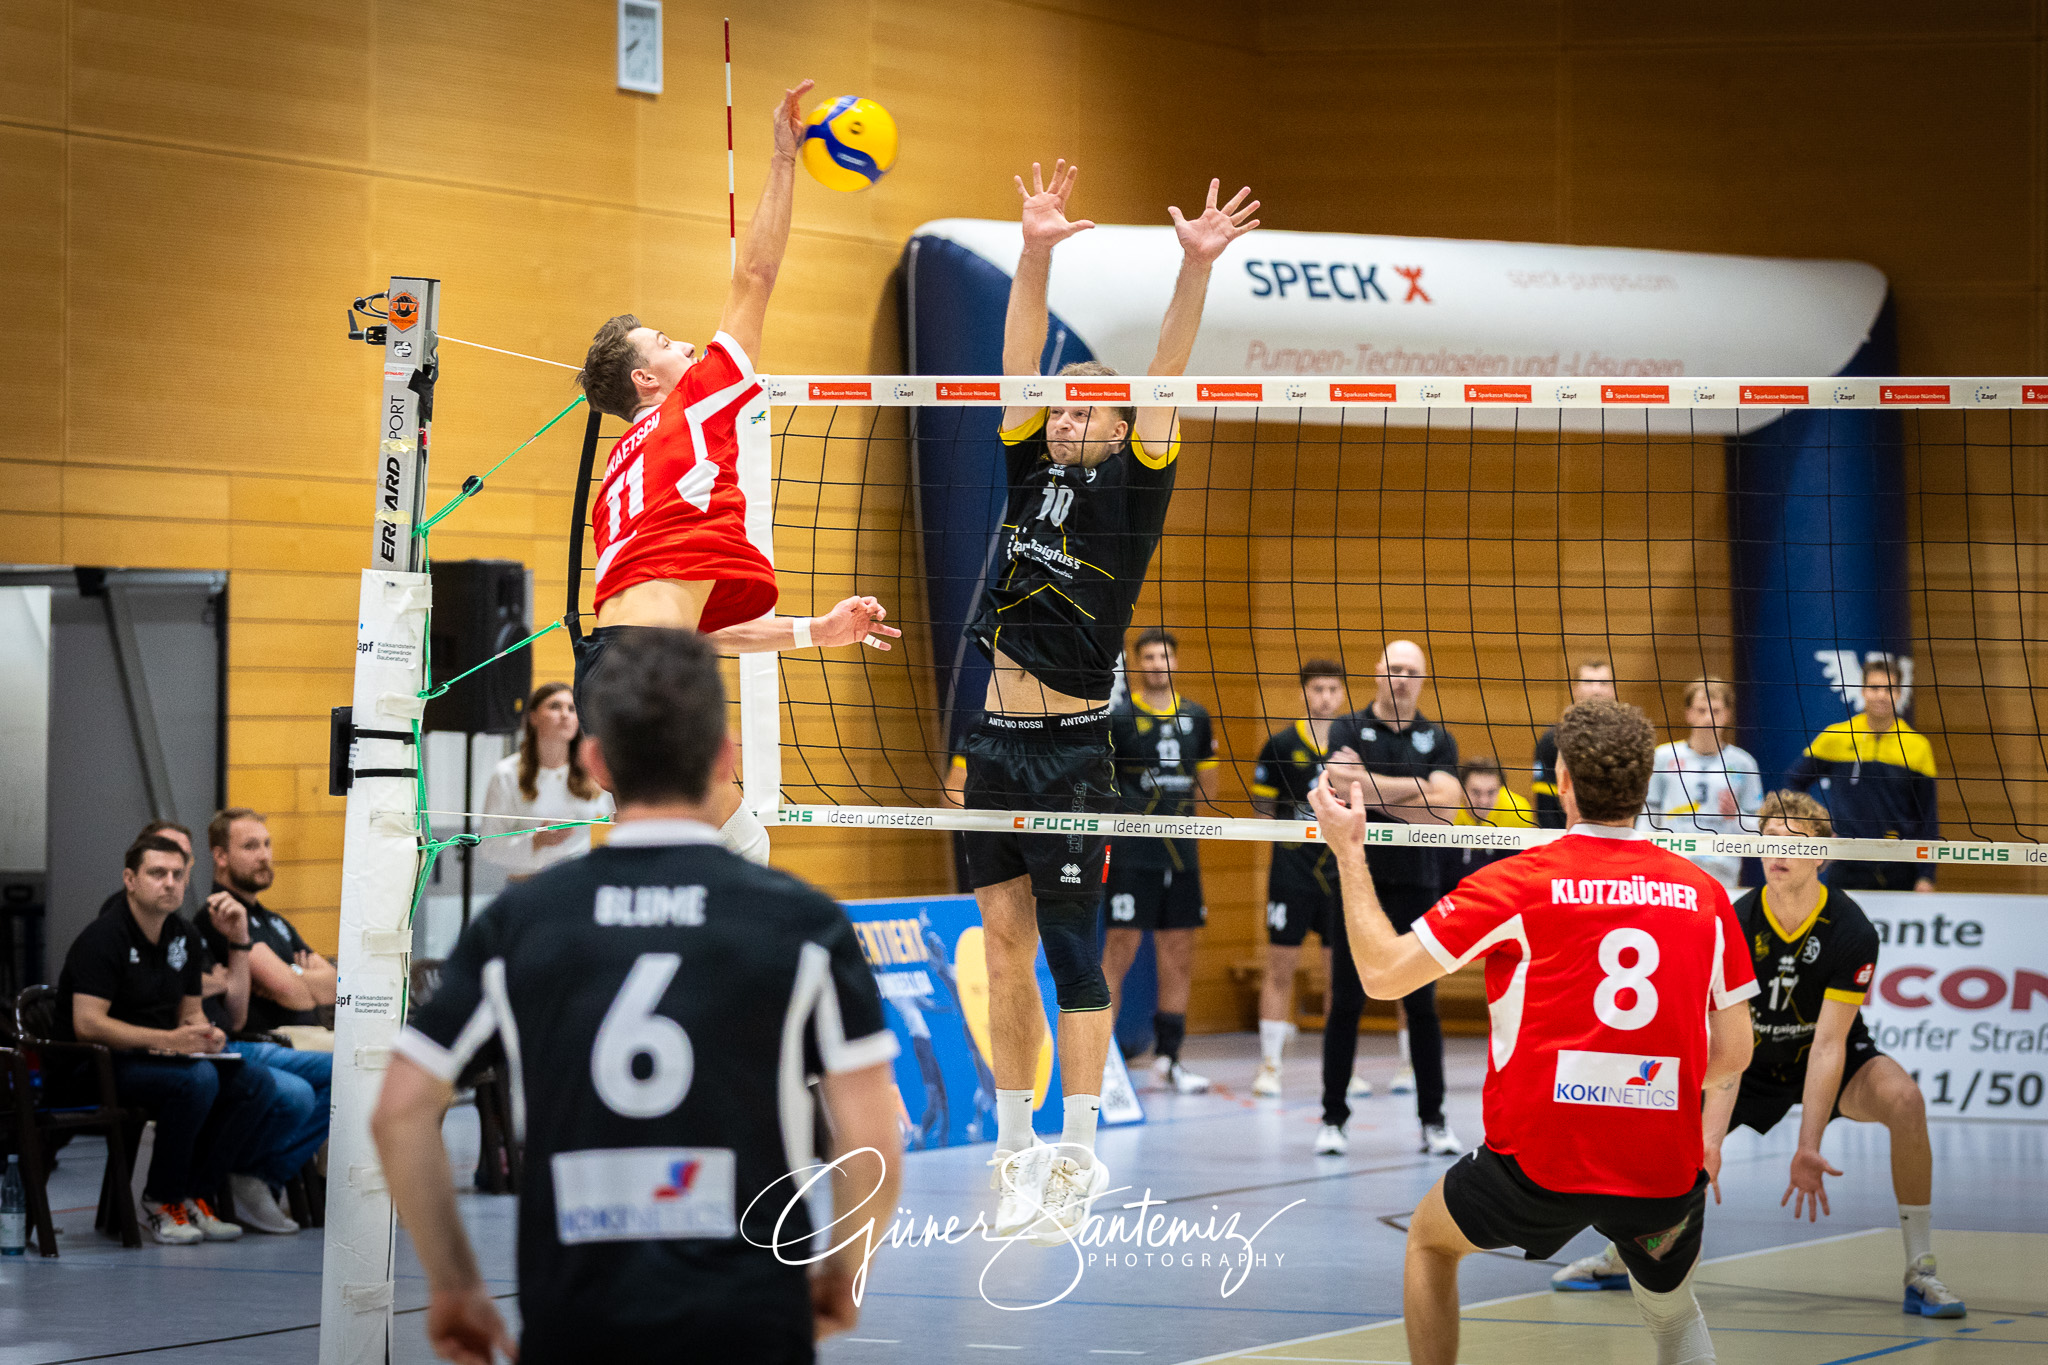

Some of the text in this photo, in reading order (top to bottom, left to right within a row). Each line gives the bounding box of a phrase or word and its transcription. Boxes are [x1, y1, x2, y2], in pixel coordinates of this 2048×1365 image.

[1245, 260, 1389, 302] SPECK
[389, 395, 405, 440] PORT
[381, 457, 400, 563] ERARD
[606, 453, 645, 543] 11
[1036, 481, 1074, 527] 10
[357, 641, 374, 654] apf
[376, 654, 409, 663] Bauberatung
[377, 642, 416, 650] Kalksandsteine
[1018, 720, 1043, 729] ROSSI
[827, 810, 863, 825] Ideen
[867, 812, 933, 827] umsetzen
[1033, 817, 1222, 836] FUCHS Ideen umsetzen
[1408, 829, 1446, 844] Ideen
[1451, 832, 1521, 847] umsetzen
[1712, 839, 1751, 854] Ideen
[1757, 842, 1828, 856] umsetzen
[1938, 847, 2048, 863] FUCHS Ide
[1060, 875, 1081, 884] errea
[593, 884, 708, 927] BLUME
[1551, 875, 1698, 912] KLOTZBÜCHER
[1111, 893, 1136, 921] 13
[1593, 927, 1661, 1031] 8
[336, 994, 352, 1007] apf
[1769, 974, 1800, 1012] 17
[589, 951, 695, 1119] 6
[1556, 1082, 1677, 1108] KOKINETICS
